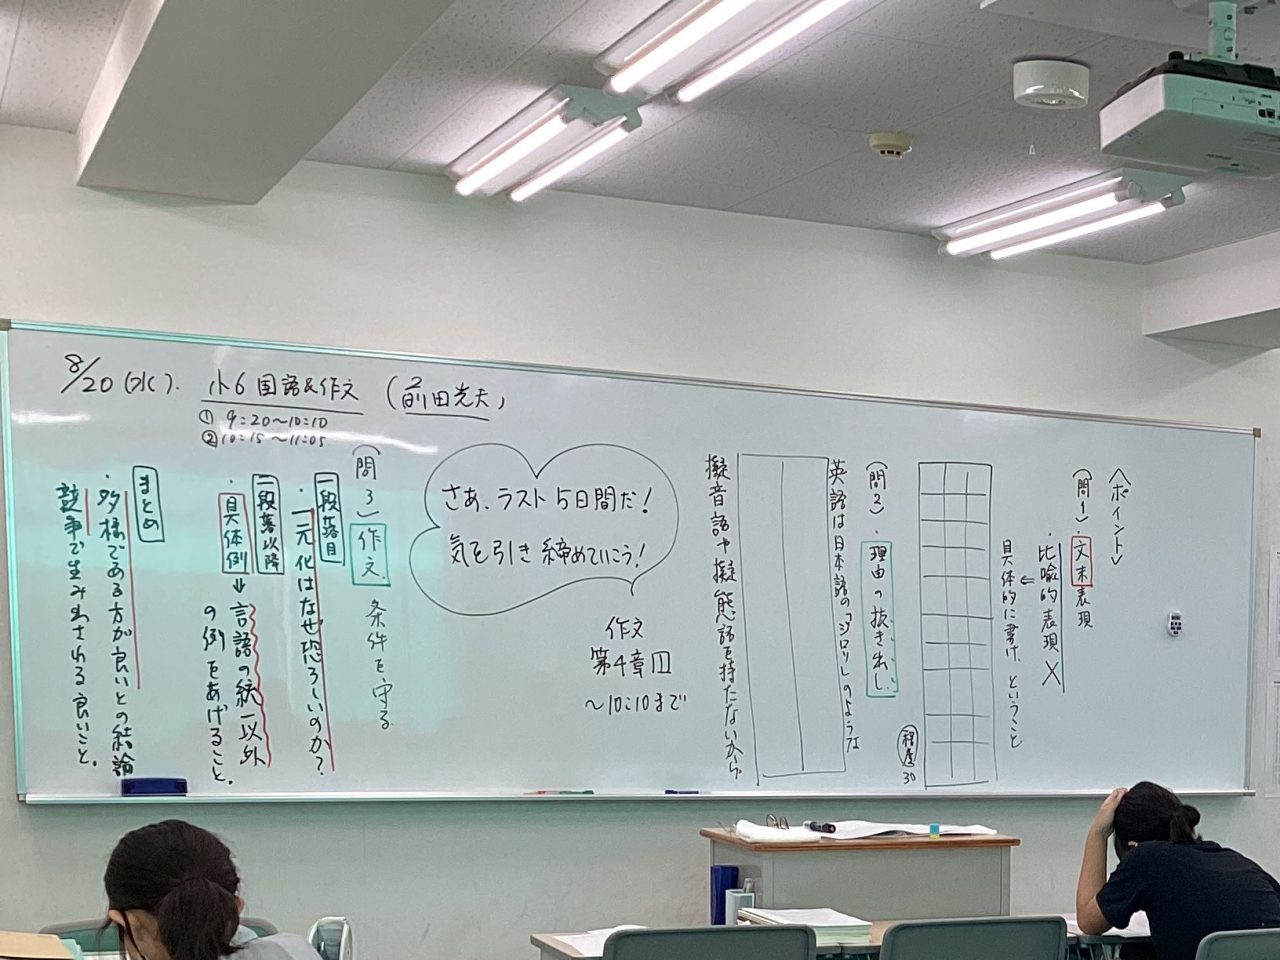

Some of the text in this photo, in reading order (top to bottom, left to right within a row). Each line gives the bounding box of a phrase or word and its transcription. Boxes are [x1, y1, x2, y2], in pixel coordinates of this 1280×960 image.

[139, 475, 159, 530] まとめ
[449, 534, 647, 568] 気を引き締めていこう!
[604, 615, 644, 641] 作文
[903, 771, 917, 784] 30
